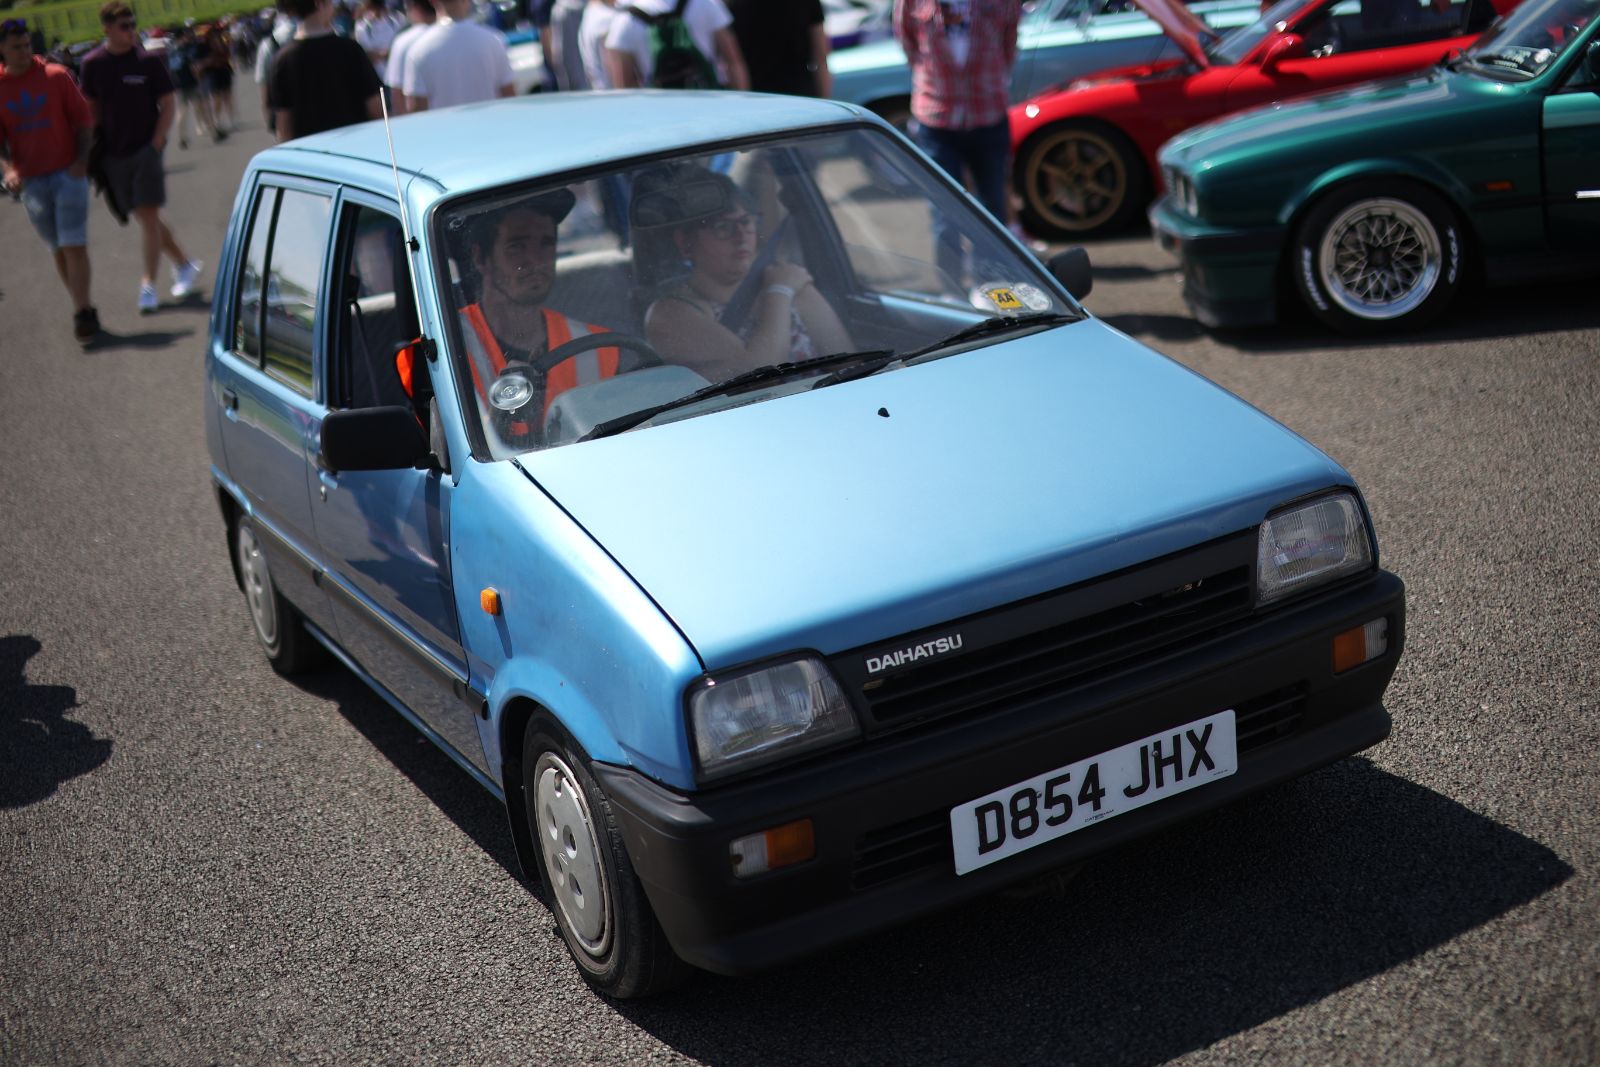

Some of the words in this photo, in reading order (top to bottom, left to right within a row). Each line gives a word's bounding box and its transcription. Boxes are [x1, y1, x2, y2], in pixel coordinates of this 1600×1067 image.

[997, 292, 1016, 303] AA
[866, 634, 963, 674] DAIHATSU
[974, 763, 1106, 856] D854
[1123, 723, 1216, 799] JHX
